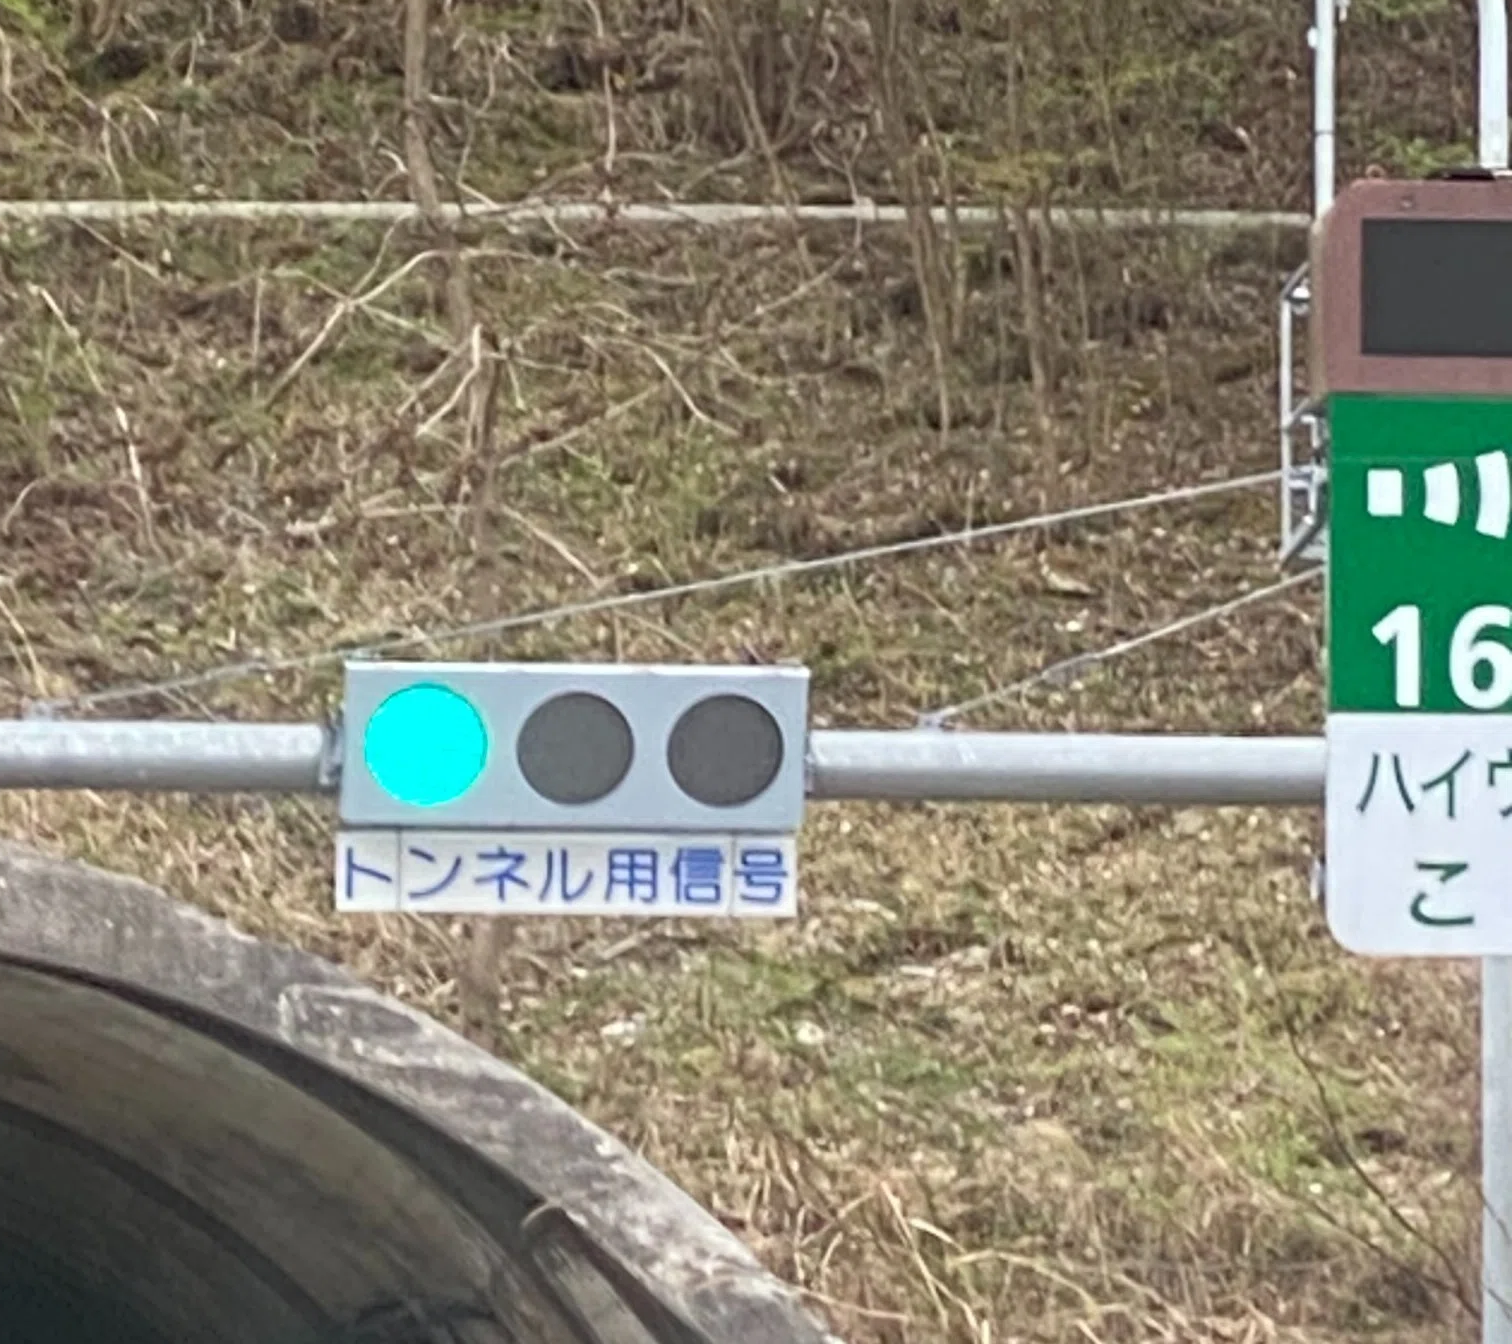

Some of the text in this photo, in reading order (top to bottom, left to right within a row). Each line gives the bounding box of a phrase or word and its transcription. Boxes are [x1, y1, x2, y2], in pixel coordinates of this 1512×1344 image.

[1371, 604, 1512, 710] 16
[345, 845, 789, 904] トンネル用信号
[1410, 860, 1476, 926] こ
